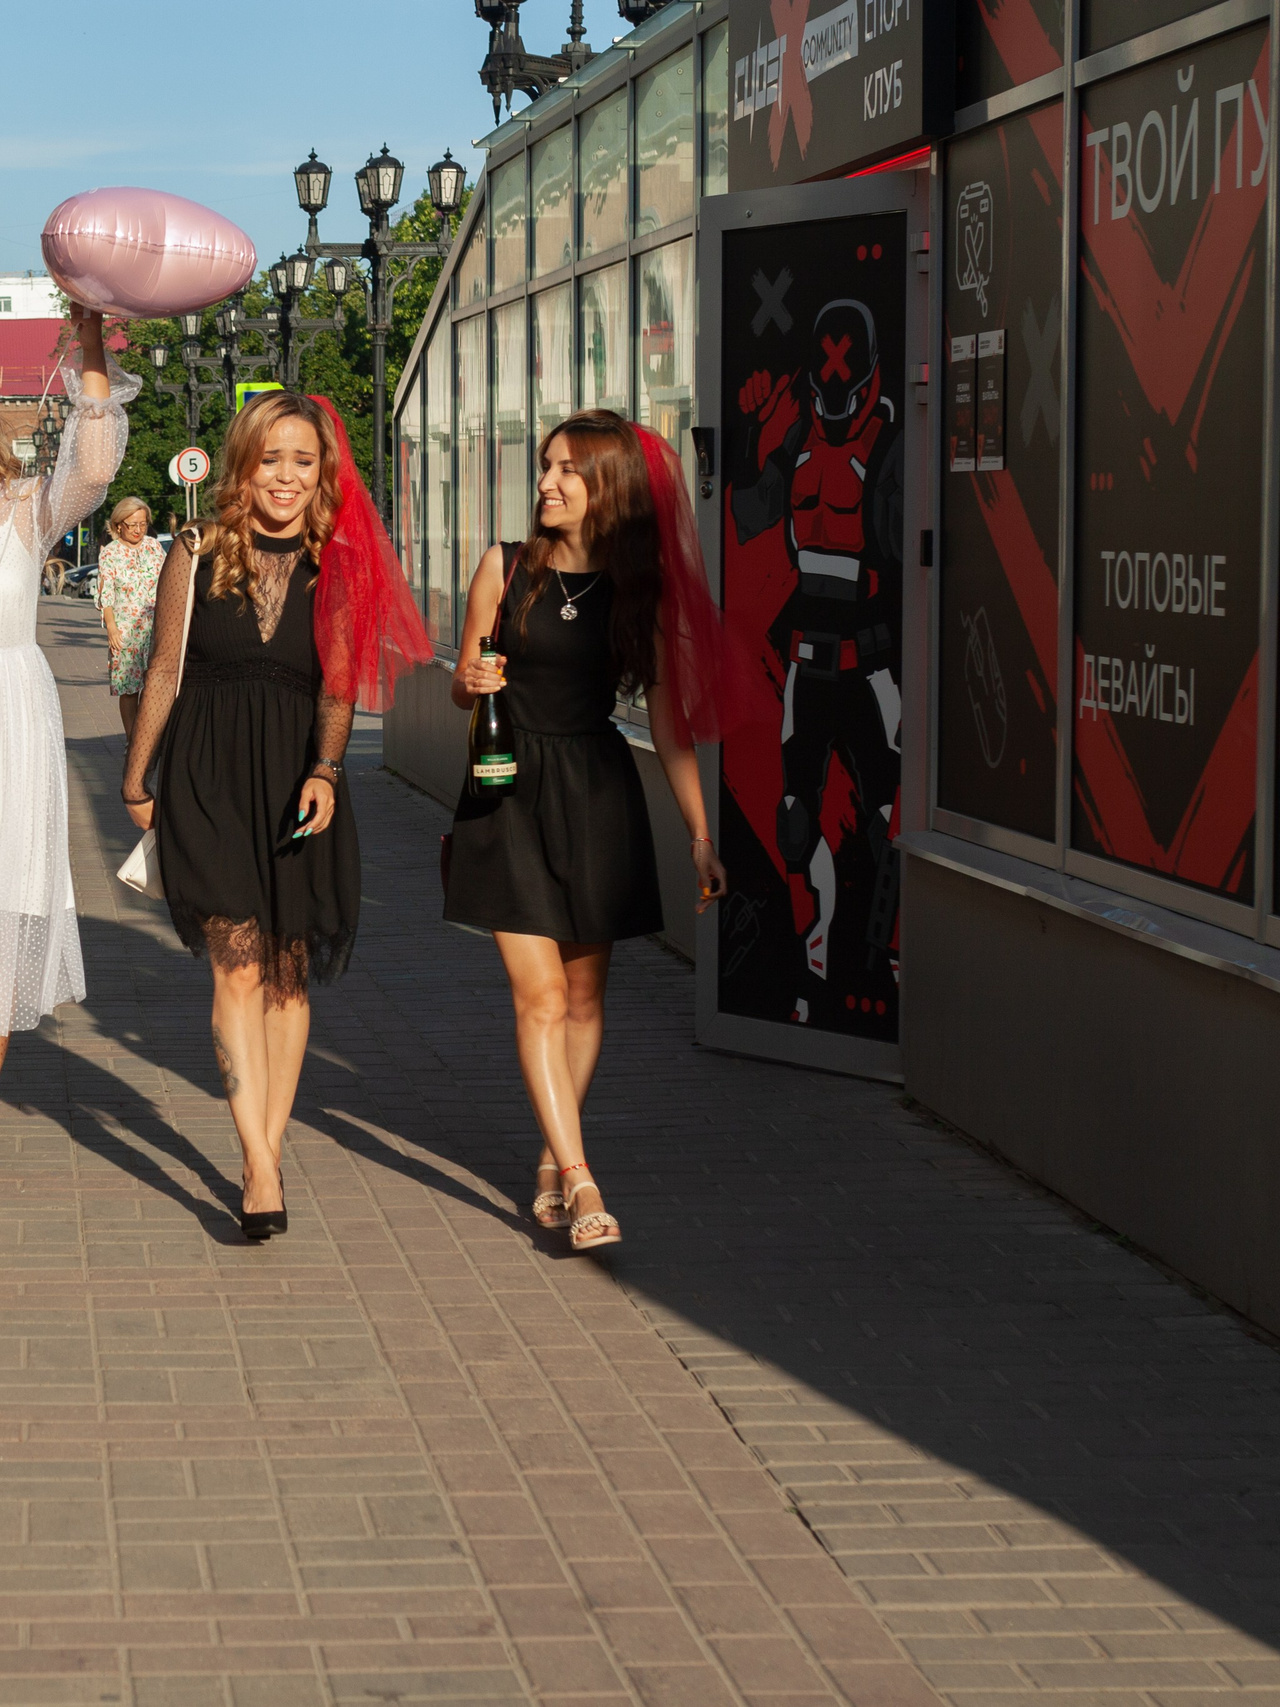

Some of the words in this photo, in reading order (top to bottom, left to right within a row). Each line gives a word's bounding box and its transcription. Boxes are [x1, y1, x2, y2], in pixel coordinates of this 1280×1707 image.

[803, 12, 854, 68] COMMUNITY
[863, 59, 903, 122] КЛУБ
[1086, 64, 1199, 225] ТВОЙ
[189, 458, 198, 472] 5
[1101, 551, 1227, 617] ТОПОВЫЕ
[1079, 643, 1195, 726] ДЕВАЙСЫ
